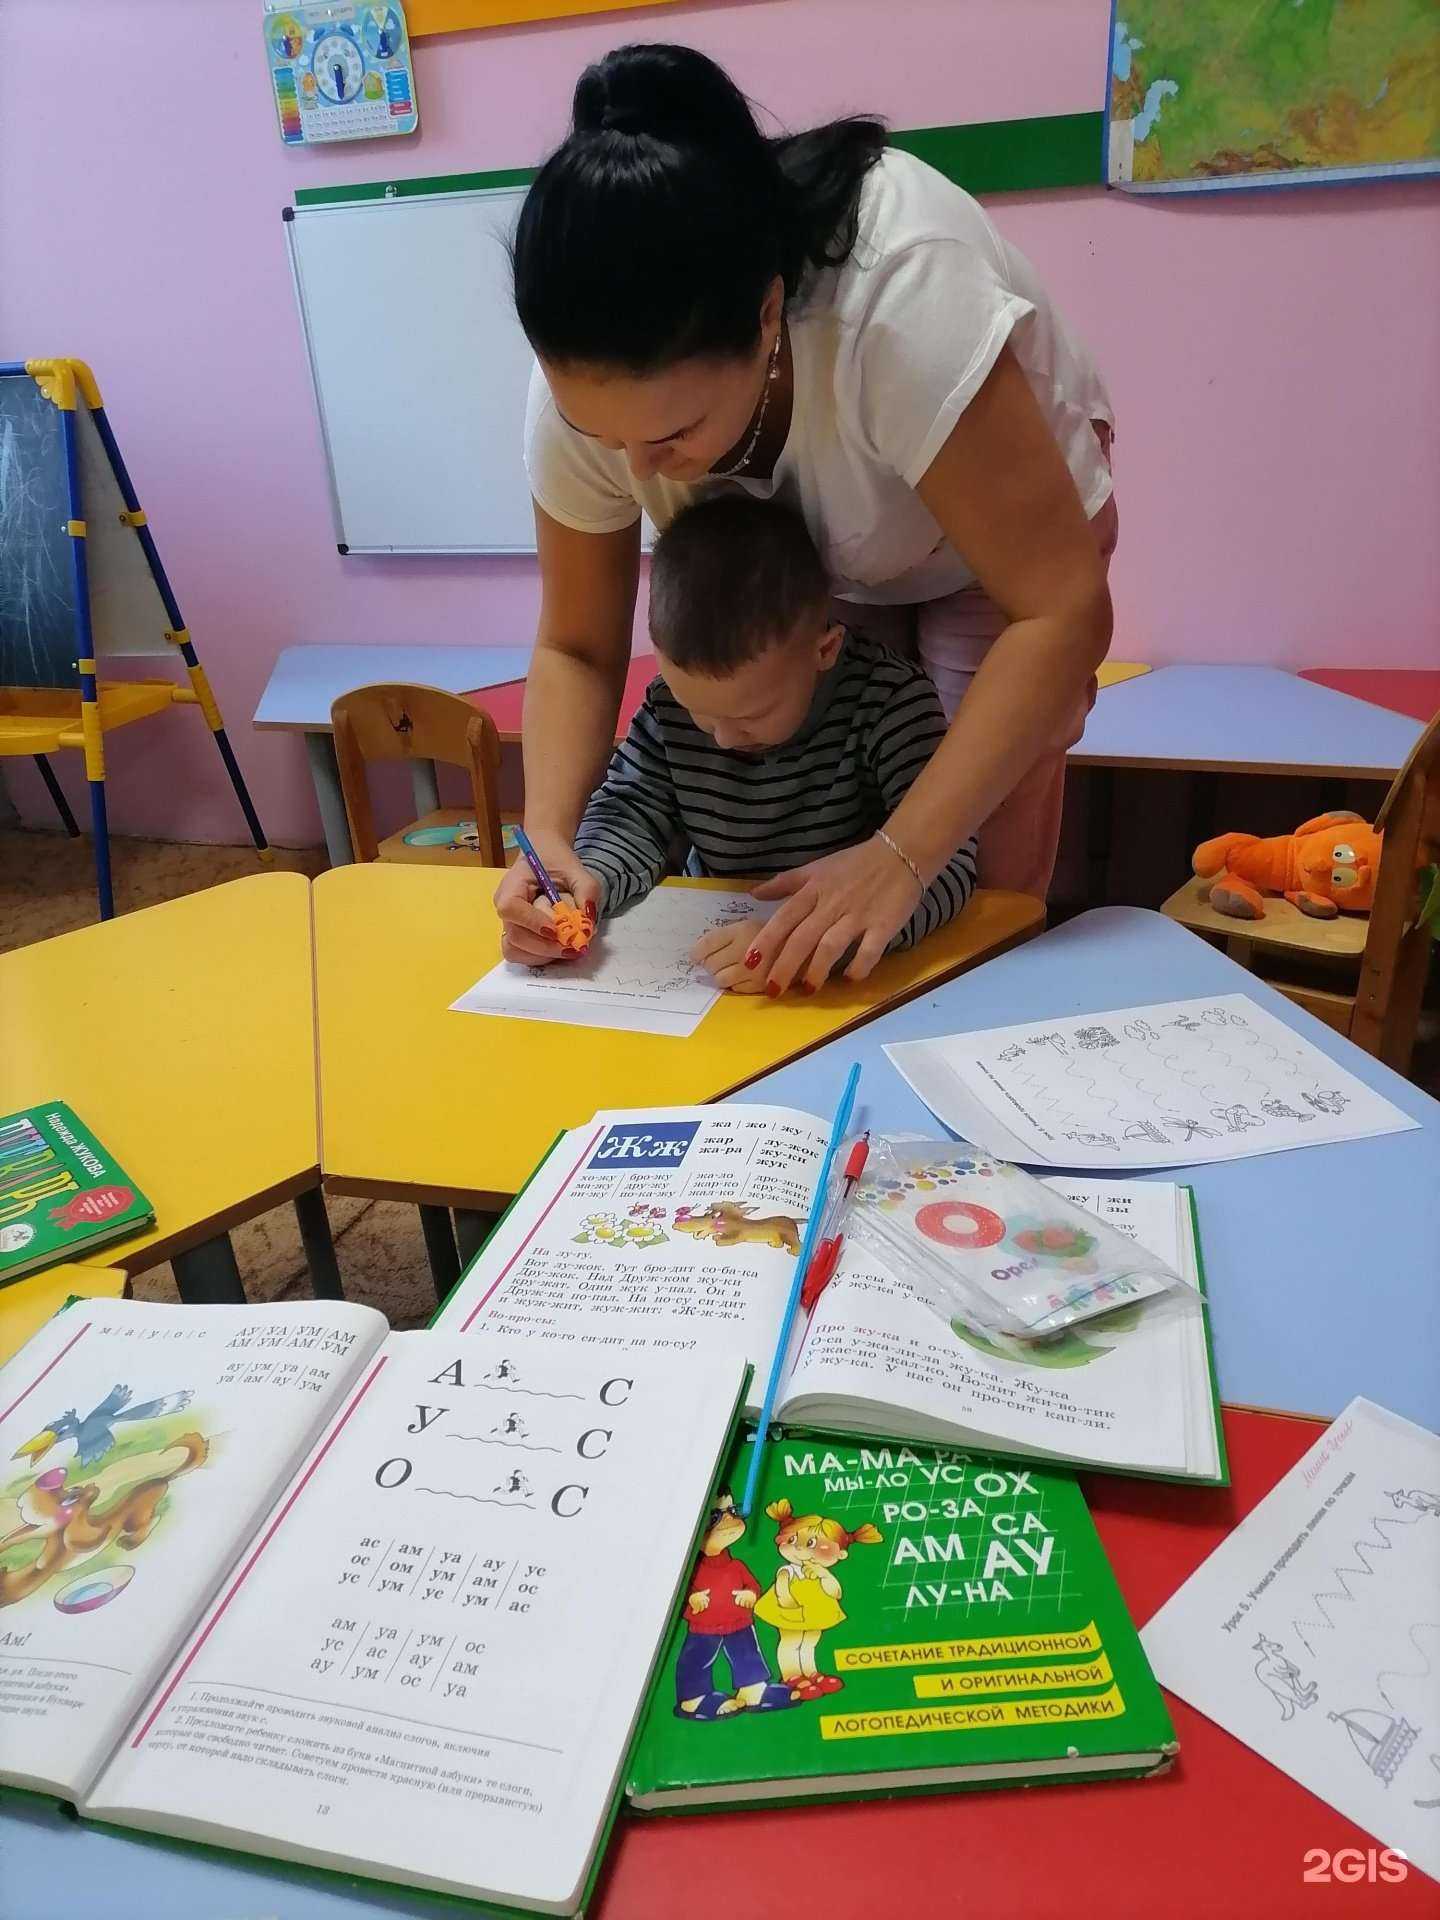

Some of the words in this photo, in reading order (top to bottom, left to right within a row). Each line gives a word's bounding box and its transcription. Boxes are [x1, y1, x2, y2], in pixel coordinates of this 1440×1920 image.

[781, 1125, 802, 1135] жу
[45, 1112, 78, 1146] Надежда
[70, 1142, 106, 1178] ЖУКОВА
[698, 1146, 742, 1154] жа-ра
[760, 1148, 808, 1164] жу-ки
[704, 1136, 734, 1144] жар
[764, 1139, 820, 1158] лу-жок
[756, 1158, 788, 1168] жук
[630, 1174, 672, 1182] бро-жу
[755, 1175, 810, 1191] дро-жит
[752, 1184, 809, 1200] кру-жит
[688, 1190, 735, 1198] жал-ко
[747, 1192, 813, 1210] жуж-жит
[915, 1200, 1006, 1249] О
[532, 1248, 550, 1256] На
[555, 1250, 592, 1260] лу-гу.
[516, 1268, 579, 1280] Дру-жок.
[588, 1272, 614, 1282] Над
[618, 1273, 690, 1284] Друж-ком
[697, 1276, 742, 1287] жу-ки
[524, 1258, 549, 1267] Вот
[553, 1262, 604, 1272] лу-жок.
[614, 1264, 638, 1274] Тут
[644, 1264, 695, 1274] бро-дит
[702, 1266, 759, 1278] со-ба-ка
[852, 1273, 885, 1284] о-сы
[504, 1285, 564, 1300] Друж-ка
[571, 1292, 620, 1302] по-пал.
[629, 1294, 649, 1302] На
[654, 1296, 692, 1306] но-су
[698, 1298, 746, 1309] си-дит
[511, 1278, 570, 1289] кру-жат.
[578, 1282, 614, 1292] Один
[619, 1284, 648, 1292] жук
[655, 1286, 697, 1296] у-пал.
[706, 1286, 728, 1296] Он
[849, 1281, 894, 1295] жу-ка
[488, 1310, 557, 1324] Во-про-сы:
[514, 1298, 583, 1311] жуж-жит,
[590, 1302, 662, 1314] жуж-жит:
[125, 1328, 135, 1336] а
[147, 1330, 160, 1340] у
[198, 1330, 206, 1338] с
[236, 1327, 260, 1337] АУ
[267, 1326, 290, 1336] УА
[296, 1326, 322, 1337] УМ
[327, 1330, 358, 1344] АМ
[225, 1338, 252, 1348] АМ
[257, 1338, 283, 1348] УМ
[286, 1338, 314, 1348] АМ
[321, 1341, 350, 1356] УМ
[497, 1325, 522, 1335] Кто
[527, 1329, 536, 1338] у
[542, 1331, 575, 1341] ко-го
[581, 1334, 625, 1345] си-дит
[631, 1338, 646, 1346] на
[652, 1340, 697, 1350] но-су?
[816, 1324, 846, 1334] Про
[852, 1326, 900, 1342] жу-ка
[909, 1338, 920, 1347] и
[928, 1343, 964, 1359] о-су.
[226, 1362, 244, 1373] ау
[252, 1362, 272, 1373] ум
[280, 1363, 298, 1373] уа
[309, 1368, 330, 1380] ам
[811, 1334, 842, 1346] О-са
[850, 1337, 940, 1366] у-жа-ли-ла
[950, 1360, 1004, 1383] жу-ка.
[1014, 1378, 1069, 1401] Жу-ка
[216, 1375, 234, 1384] уа
[243, 1374, 263, 1384] ам
[272, 1375, 292, 1386] ау
[299, 1380, 322, 1392] ум
[428, 1359, 465, 1387] А
[600, 1378, 634, 1406] С
[819, 1355, 874, 1370] жу-ка.
[906, 1370, 934, 1386] нас
[942, 1382, 962, 1393] он
[971, 1389, 1036, 1414] про-сит
[1045, 1410, 1112, 1430] кап-ли.
[886, 1353, 950, 1378] жал-ко.
[960, 1374, 1016, 1397] Бо-лит
[1026, 1394, 1117, 1420] жи-во-тик
[407, 1404, 450, 1434] У
[576, 1428, 612, 1460] С
[784, 1447, 923, 1476] МА-МА
[375, 1458, 412, 1488] О
[551, 1484, 590, 1518] С
[824, 1473, 909, 1492] МЫ-ЛО
[920, 1465, 965, 1486] УС
[974, 1470, 1040, 1498] ОХ
[883, 1498, 986, 1524] РО-ЗА
[991, 1512, 1050, 1536] СА
[360, 1536, 381, 1549] ас
[398, 1543, 424, 1558] ам
[440, 1551, 462, 1564] уа
[482, 1558, 506, 1572] ау
[524, 1564, 546, 1578] ус
[894, 1534, 966, 1566] АМ
[982, 1536, 1056, 1580] АУ
[1221, 1611, 1244, 1633] Урок
[1246, 1570, 1276, 1600] Учимся
[1274, 1532, 1310, 1572] проводить
[1324, 1496, 1336, 1508] по
[1332, 1471, 1356, 1496] точкам
[350, 1554, 372, 1566] ос
[390, 1561, 414, 1574] ом
[429, 1567, 456, 1582] ум
[472, 1575, 498, 1589] ам
[518, 1582, 540, 1596] ос
[338, 1570, 361, 1584] ус
[378, 1578, 405, 1592] ум
[422, 1586, 444, 1601] ус
[462, 1593, 489, 1608] ум
[508, 1600, 530, 1614] ас
[906, 1580, 1014, 1608] ЛУ-НА
[331, 1617, 357, 1632] ам
[375, 1626, 398, 1642] уа
[416, 1634, 444, 1648] ум
[464, 1641, 486, 1654] ос
[321, 1638, 344, 1652] ус
[366, 1646, 388, 1660] ас
[409, 1652, 433, 1670] ау
[452, 1660, 480, 1676] ам
[846, 1646, 945, 1666] СОЧЕТАНИЕ
[950, 1634, 1093, 1658] ТРАДИЦИОННОЙ
[310, 1657, 335, 1674] ау
[351, 1665, 380, 1681] ум
[400, 1674, 422, 1688] ос
[443, 1682, 467, 1698] уа
[940, 1678, 954, 1691] И
[959, 1666, 1104, 1691] ОРИГИНАЛЬНОЙ
[833, 1706, 1005, 1734] ЛОГОПЕДИЧЕСКОЙ
[1015, 1700, 1116, 1720] МЕТОДИКИ
